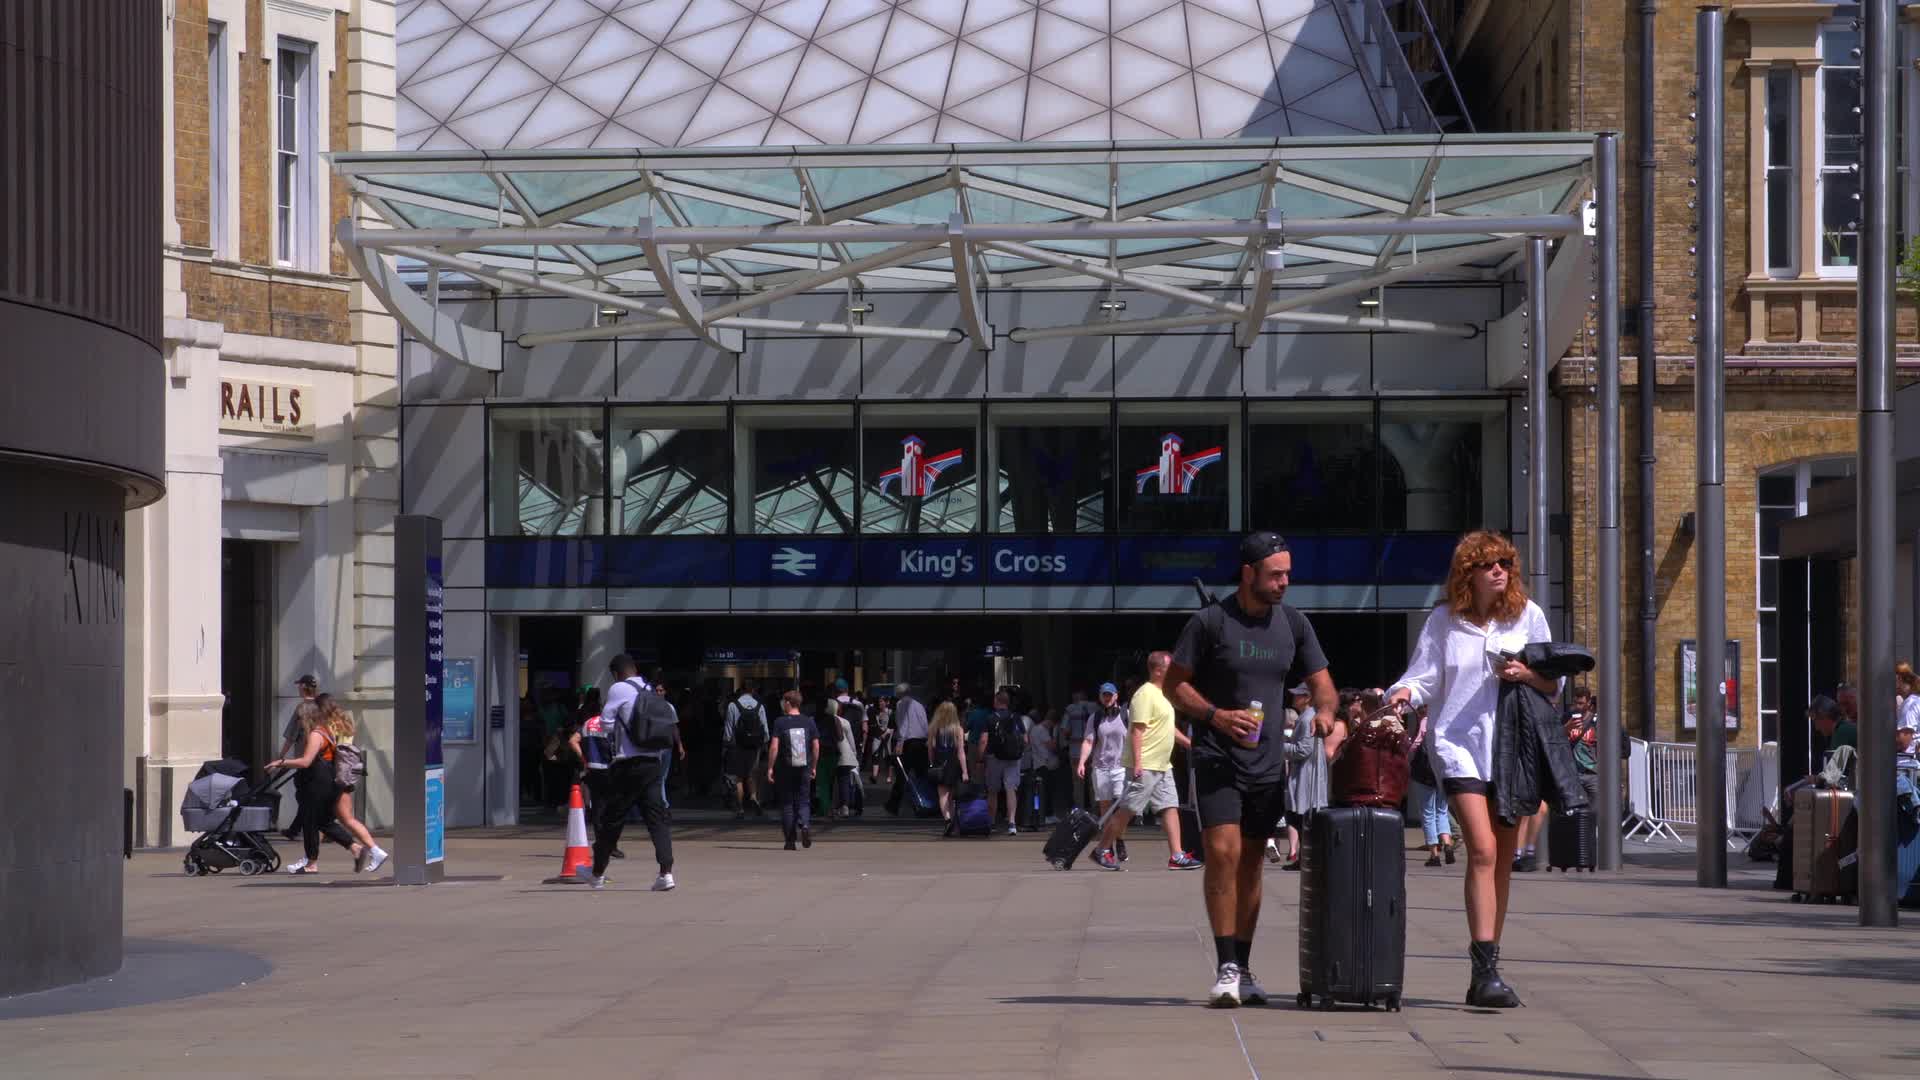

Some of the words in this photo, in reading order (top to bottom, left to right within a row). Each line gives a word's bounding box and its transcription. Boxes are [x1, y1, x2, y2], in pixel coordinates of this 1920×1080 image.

[221, 381, 301, 425] RAILS
[900, 549, 974, 578] King's
[994, 549, 1067, 573] Cross
